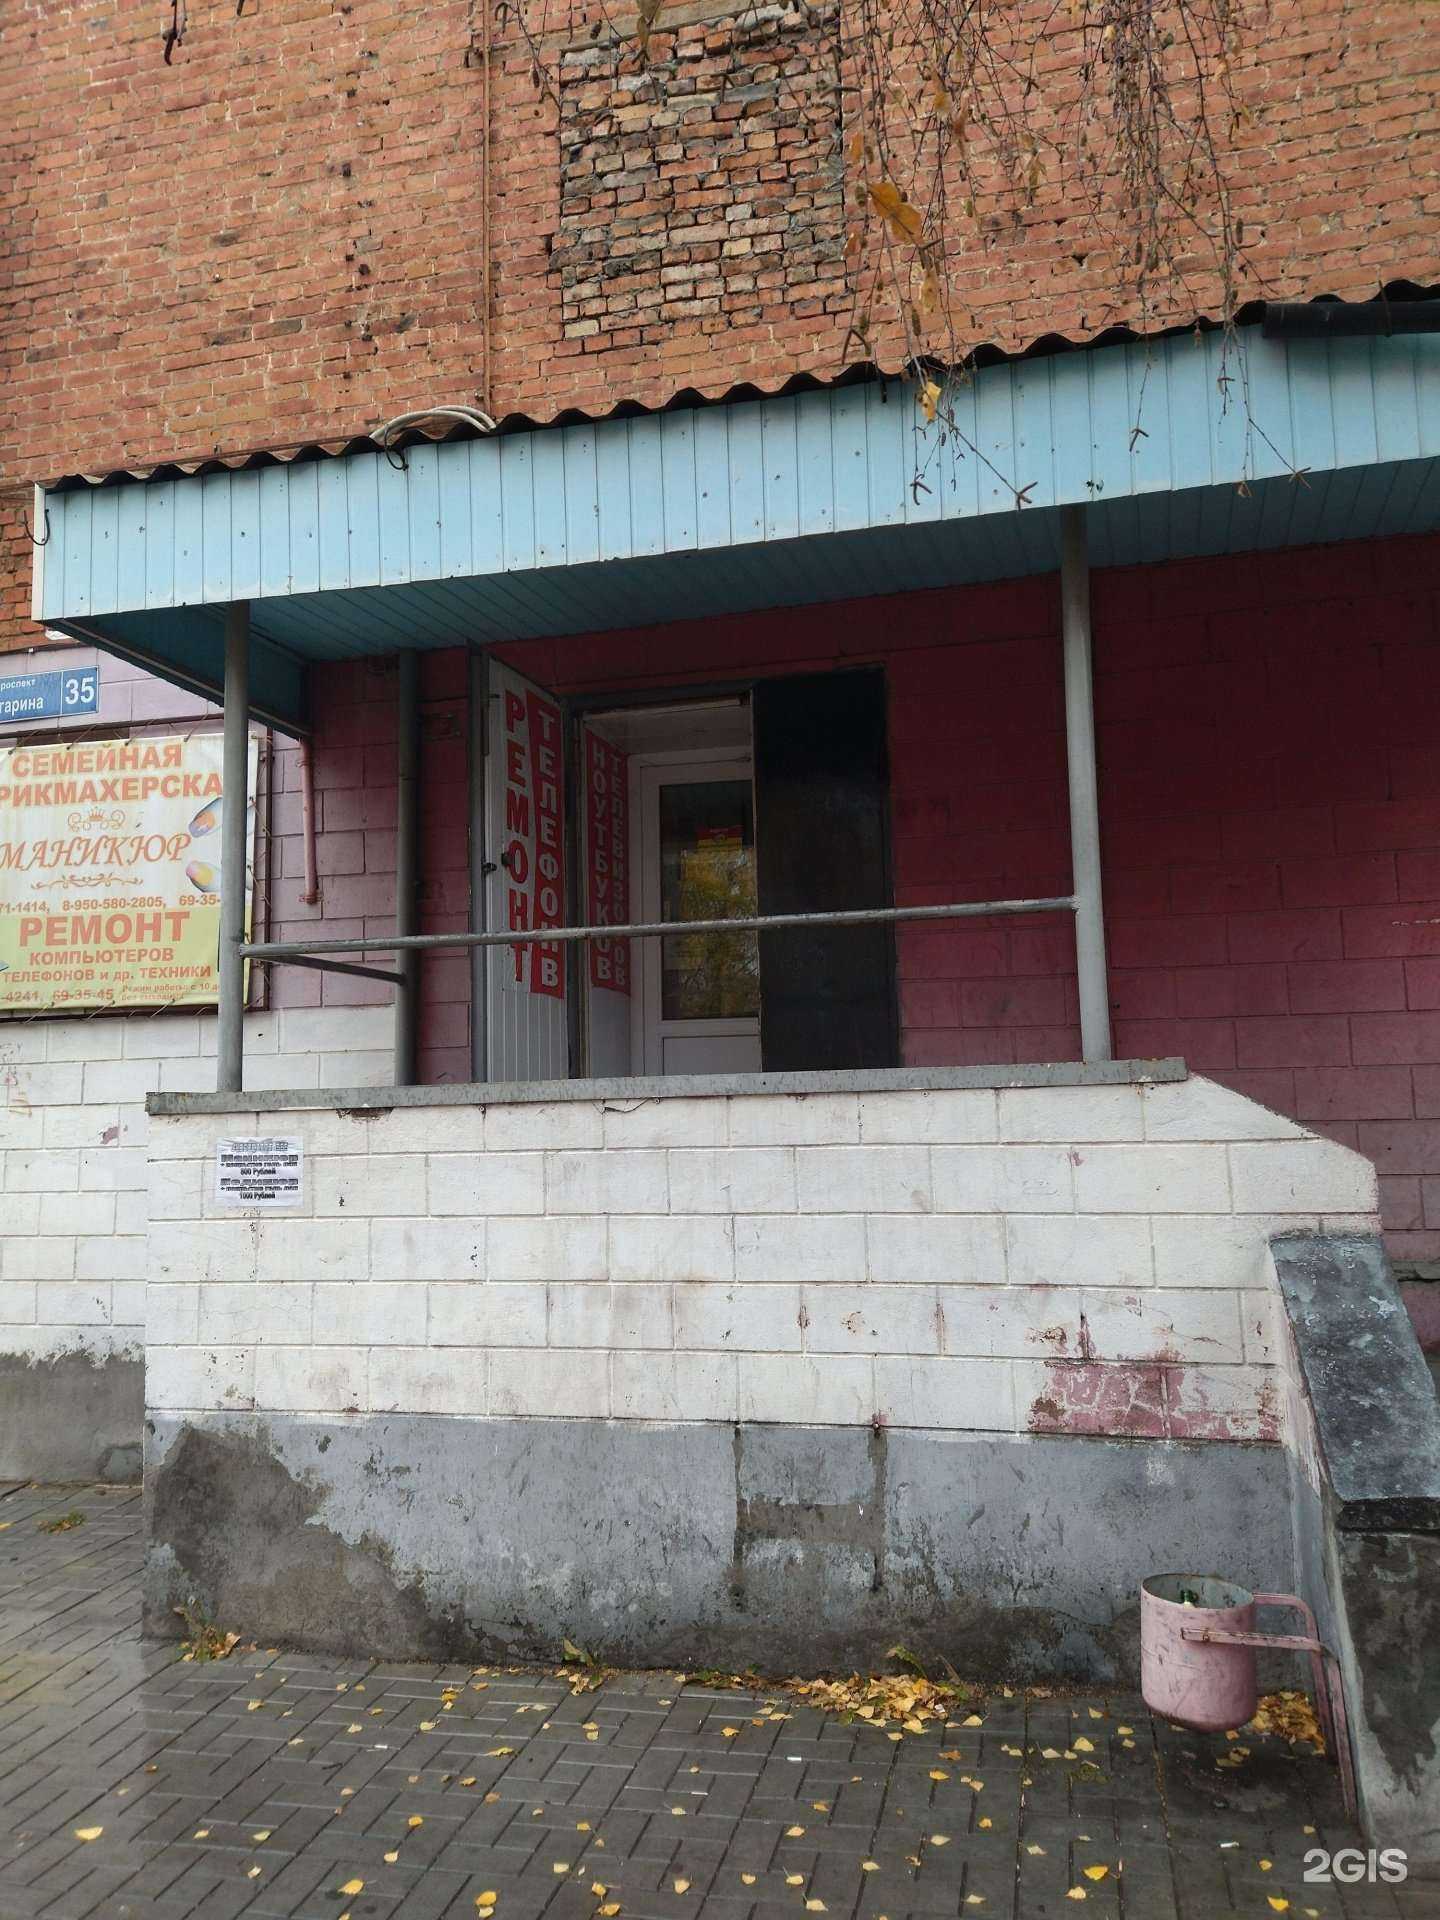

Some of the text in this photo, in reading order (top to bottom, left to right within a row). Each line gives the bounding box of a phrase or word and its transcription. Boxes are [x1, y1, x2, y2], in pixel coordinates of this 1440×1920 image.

[65, 676, 95, 705] 35
[12, 743, 183, 778] СЕМЕЙНАЯ
[0, 832, 191, 872] МАНИКЮР
[504, 688, 529, 982] РЕМОНТ
[610, 751, 625, 986] ТЕЛЕВИЗООВ
[62, 897, 166, 911] 8-950-580-2805,
[19, 911, 190, 948] РЕМОНТ
[4, 965, 211, 984] ТЕЛЕФОНОВ и др. ТЕХНИКИ
[29, 948, 174, 966] КОМПЬЮТЕРОВ
